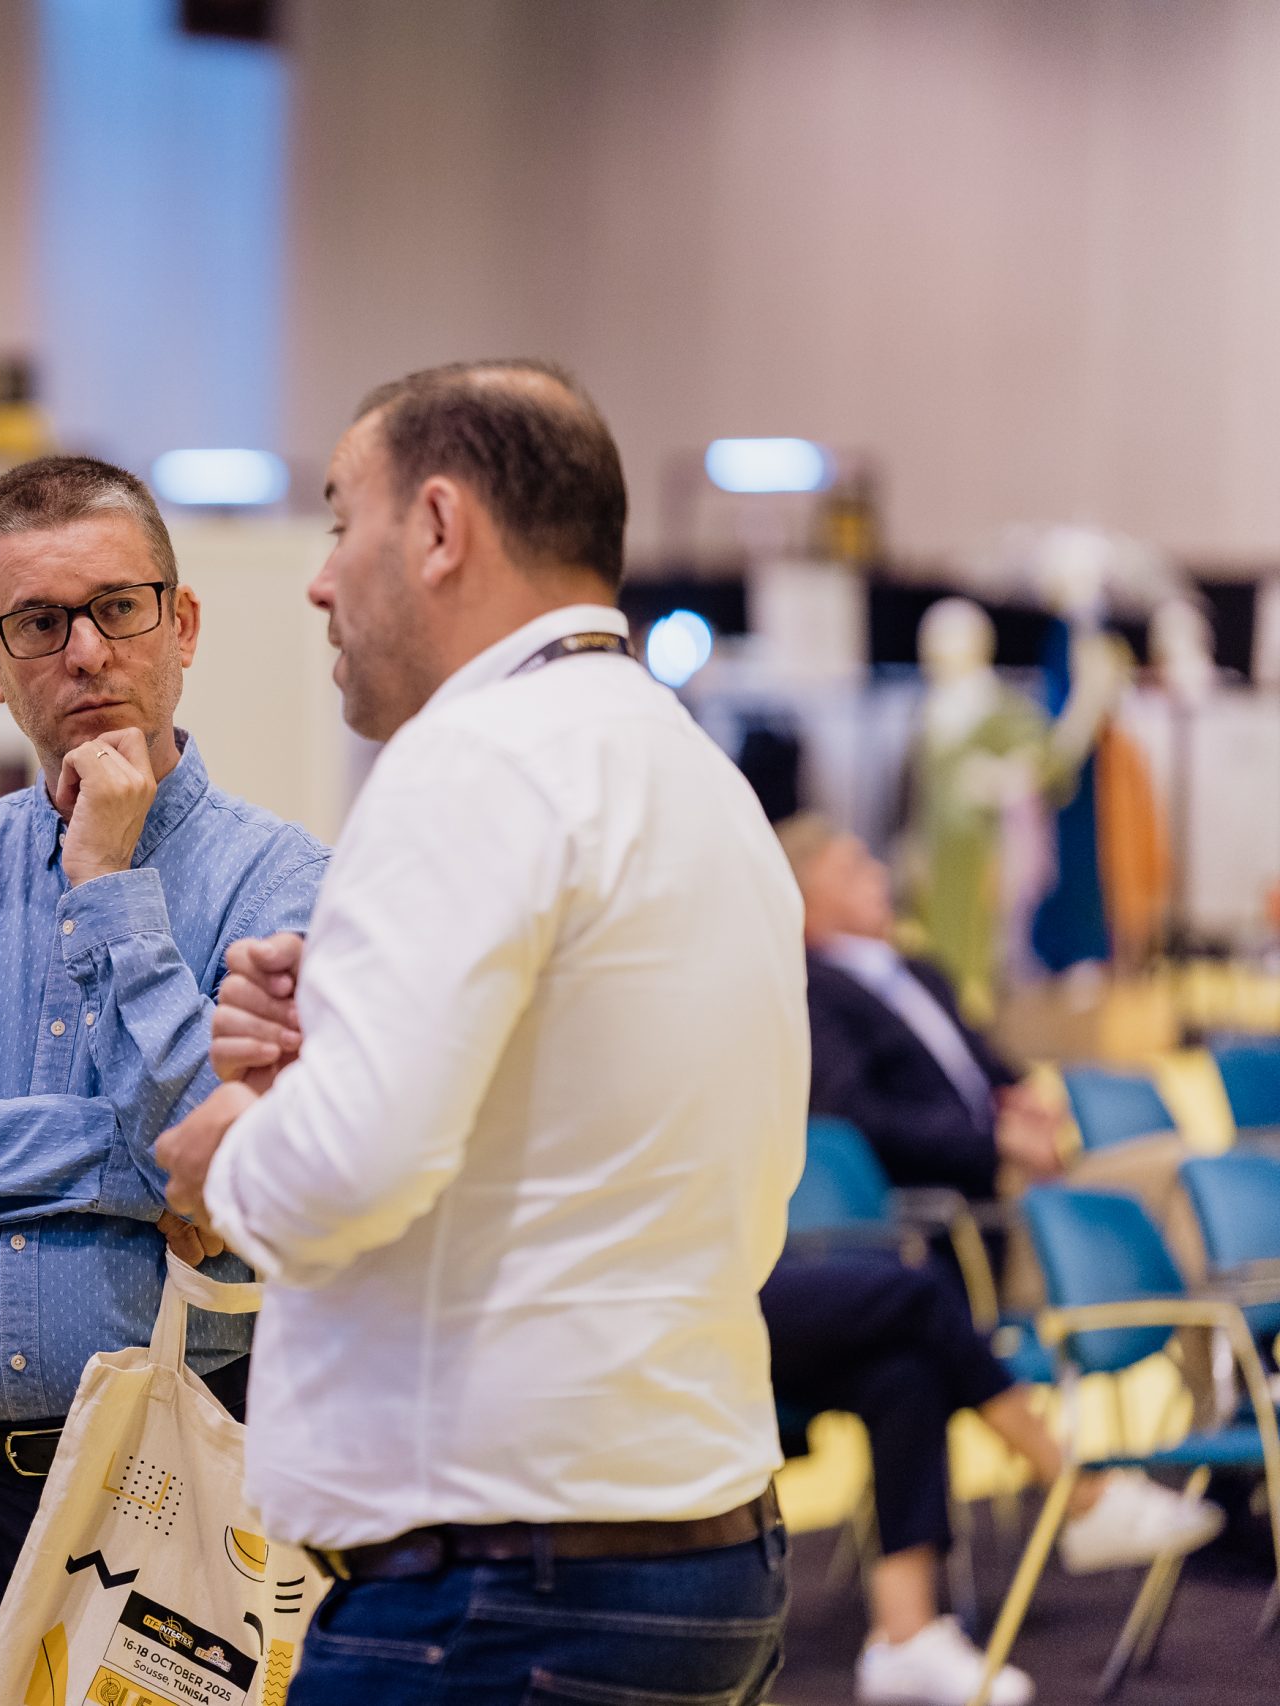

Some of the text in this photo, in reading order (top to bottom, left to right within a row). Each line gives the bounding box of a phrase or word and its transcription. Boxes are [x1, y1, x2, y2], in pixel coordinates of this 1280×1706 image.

[160, 1624, 193, 1647] INTERTEX
[123, 1637, 149, 1658] 16-18
[150, 1653, 204, 1688] OCTOBER
[204, 1681, 232, 1702] 2025
[133, 1659, 210, 1706] Sousse, TUNISIA
